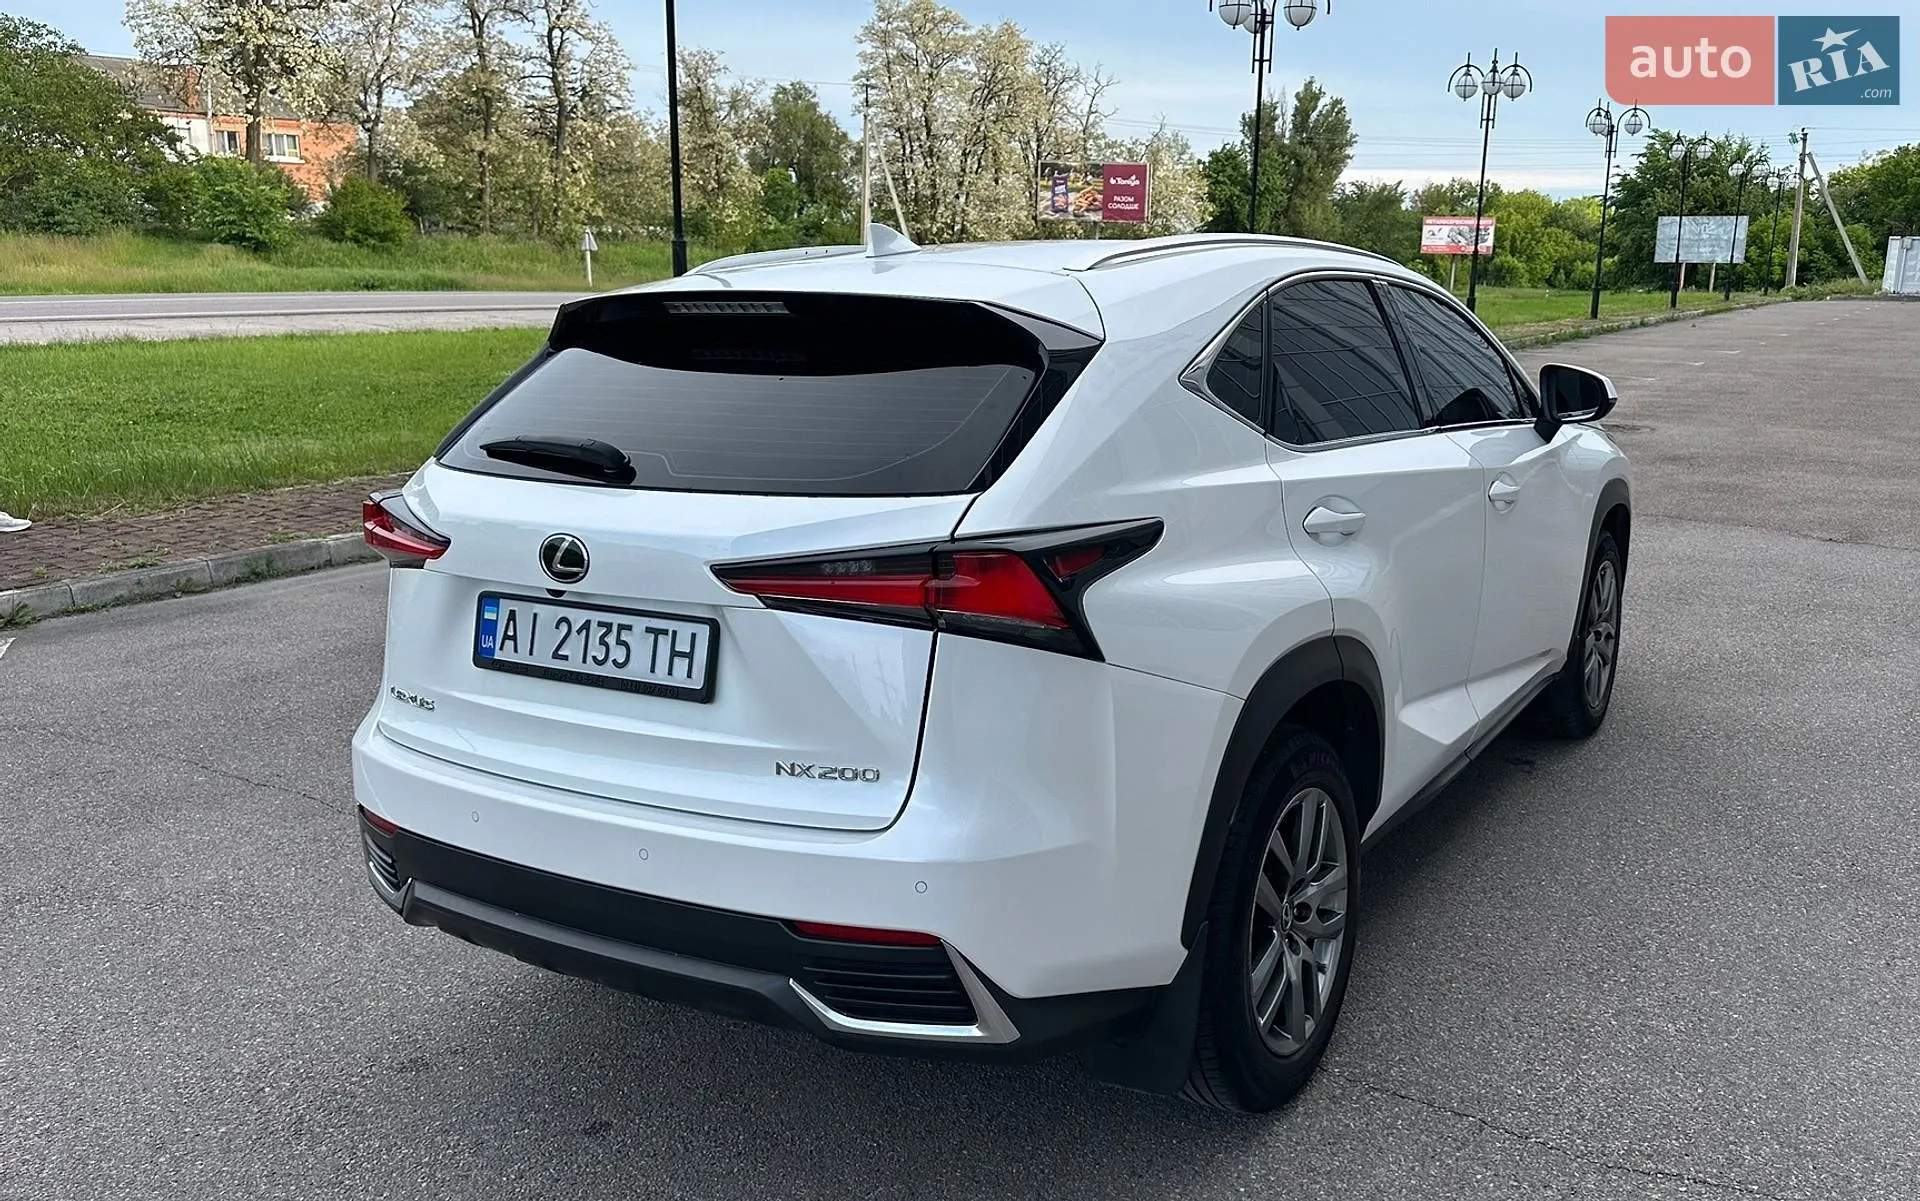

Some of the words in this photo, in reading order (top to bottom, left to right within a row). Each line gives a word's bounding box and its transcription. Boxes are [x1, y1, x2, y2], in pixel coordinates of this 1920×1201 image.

[481, 634, 494, 649] UA
[551, 616, 634, 669] 2135
[645, 626, 697, 679] TH
